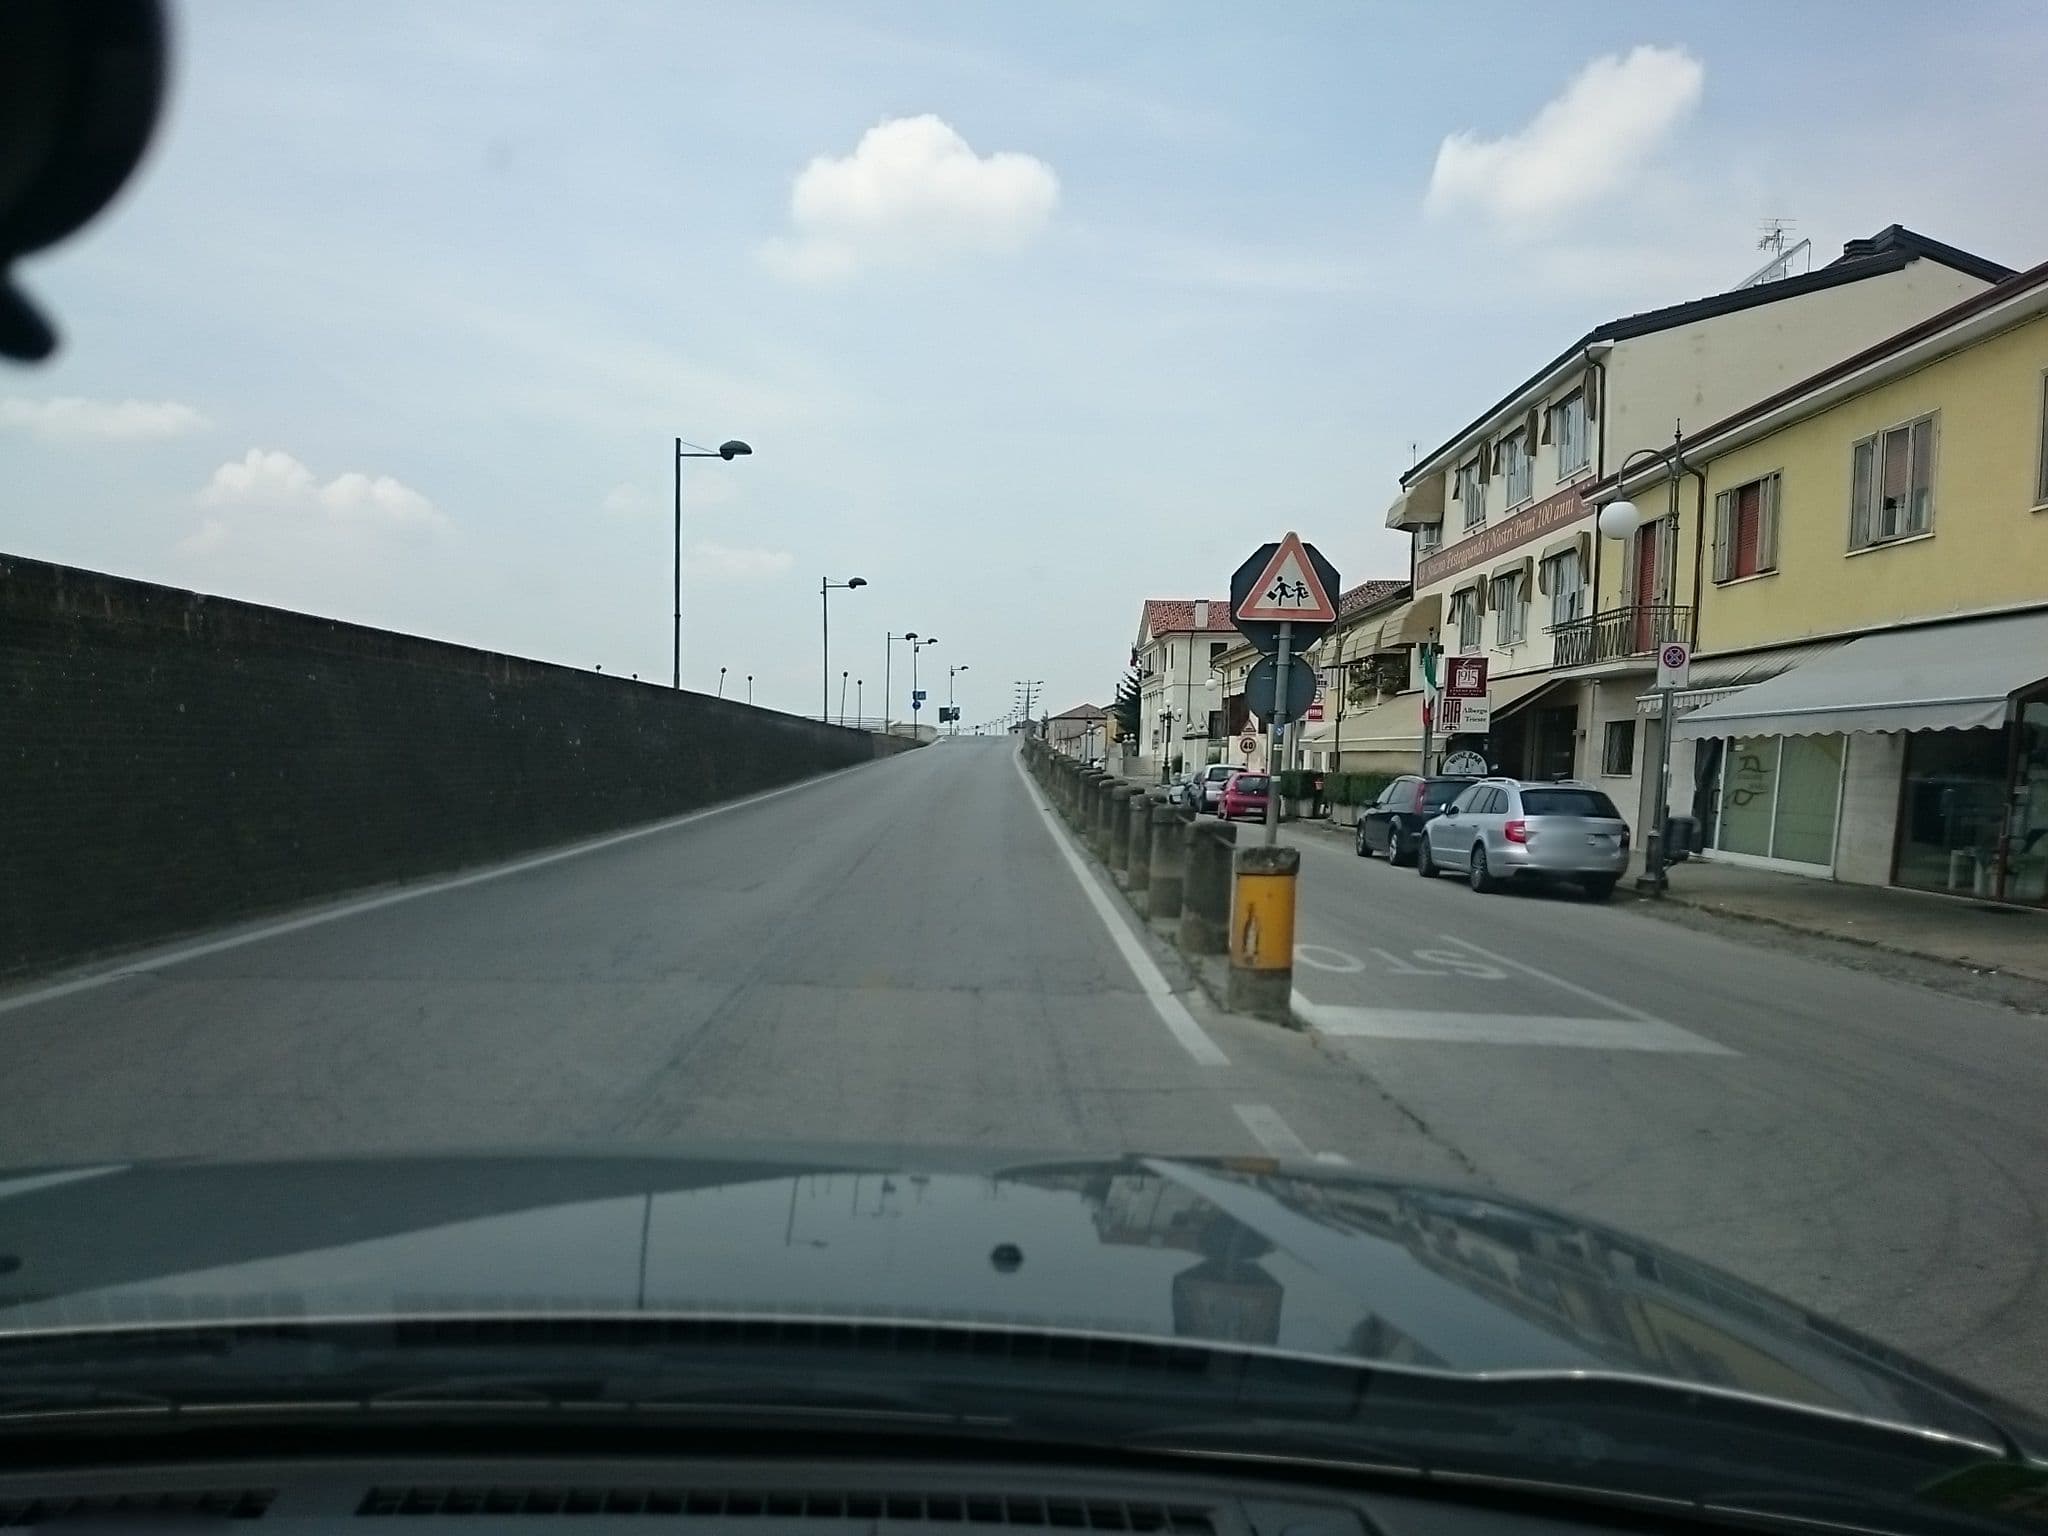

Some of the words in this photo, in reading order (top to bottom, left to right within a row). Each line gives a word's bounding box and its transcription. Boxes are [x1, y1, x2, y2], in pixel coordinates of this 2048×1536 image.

[1489, 521, 1514, 551] Nostri
[1537, 503, 1553, 528] 100
[1553, 491, 1575, 521] anni
[1243, 741, 1253, 749] 40
[1292, 943, 1508, 981] STO
